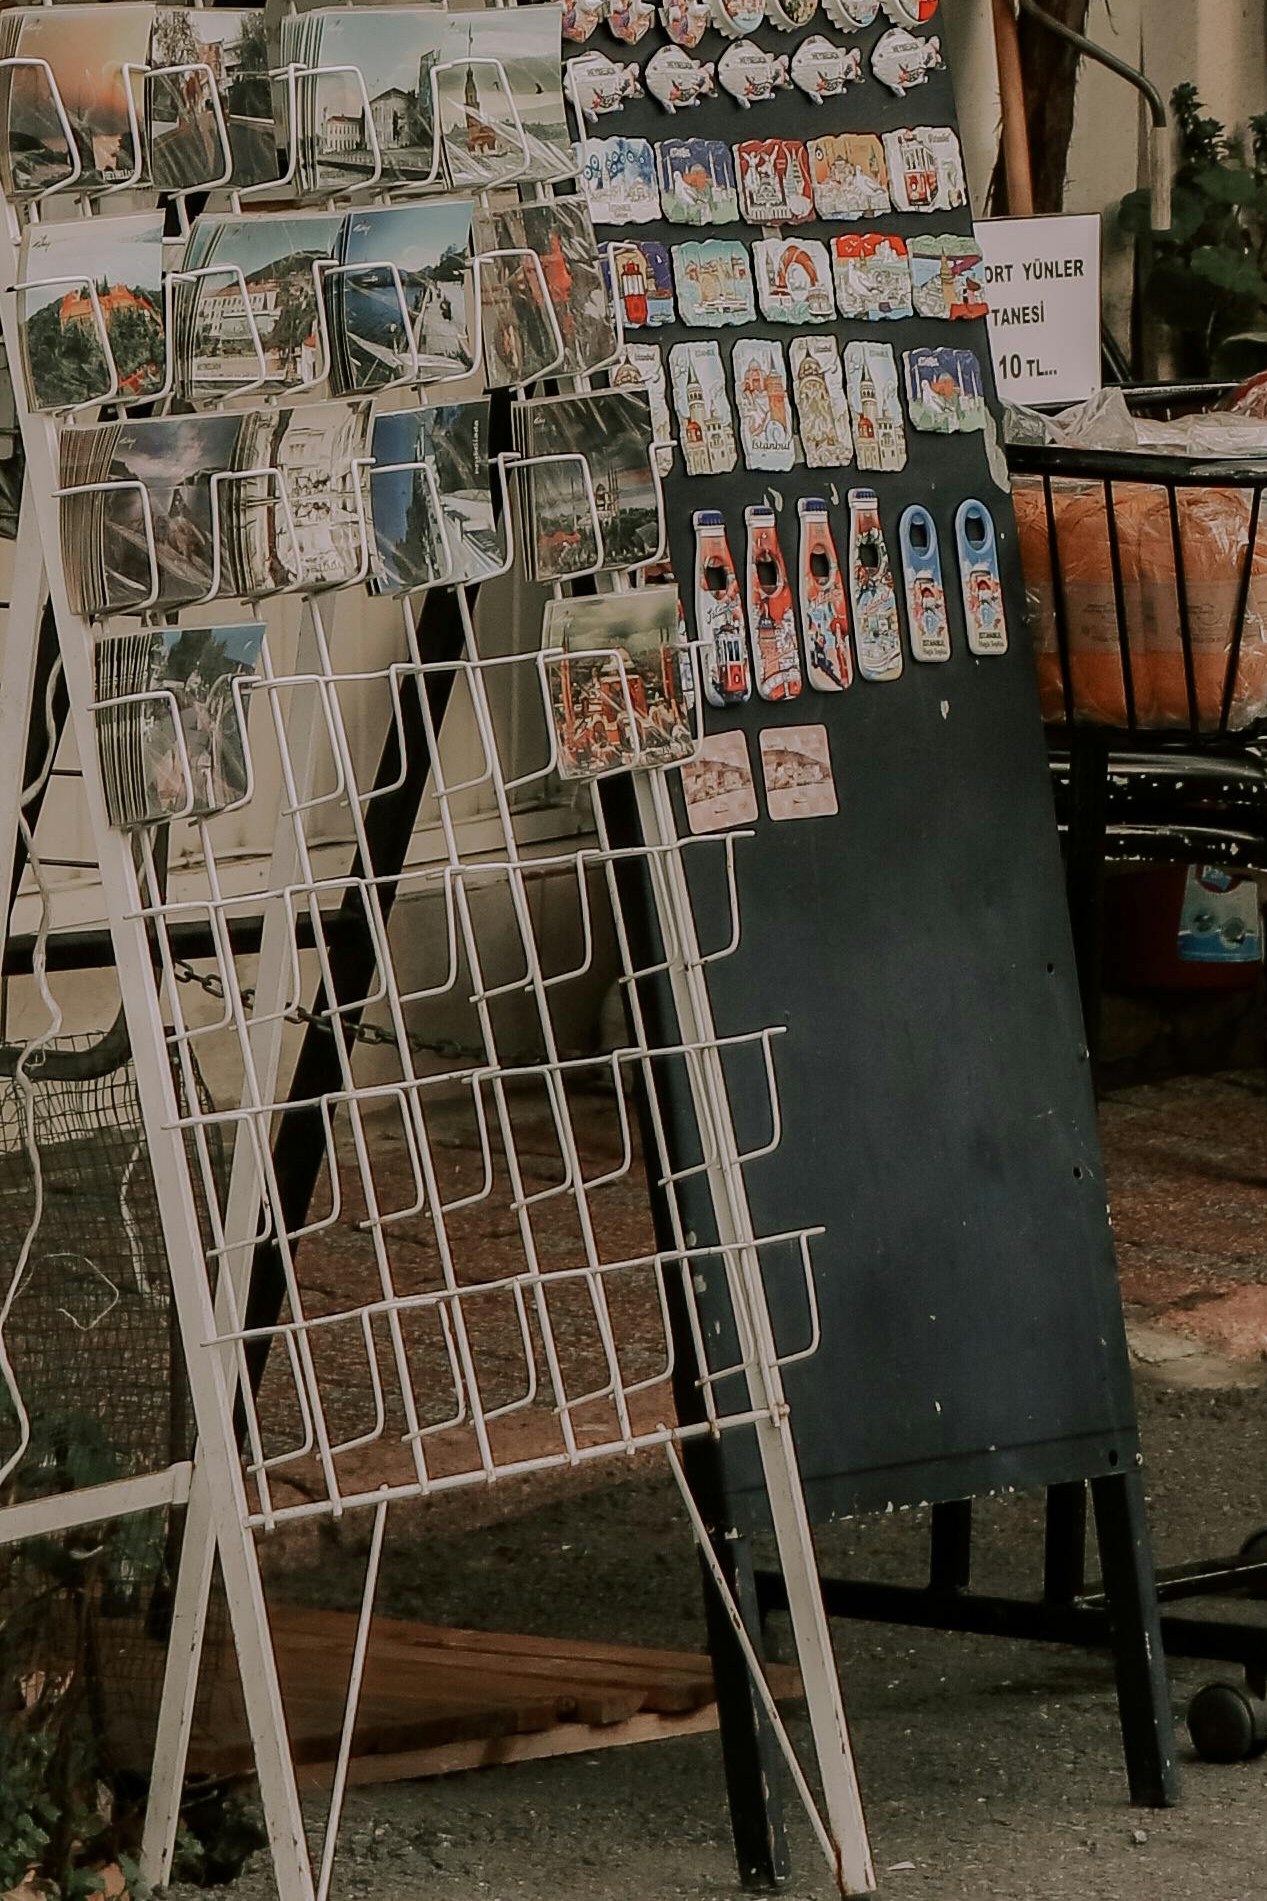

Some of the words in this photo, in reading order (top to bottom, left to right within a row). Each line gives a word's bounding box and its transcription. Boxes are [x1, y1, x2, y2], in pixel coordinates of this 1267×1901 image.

[1022, 258, 1085, 282] YÜNLER
[991, 300, 1045, 327] TANESİ
[999, 353, 1022, 380] 10
[1026, 358, 1058, 377] TL...
